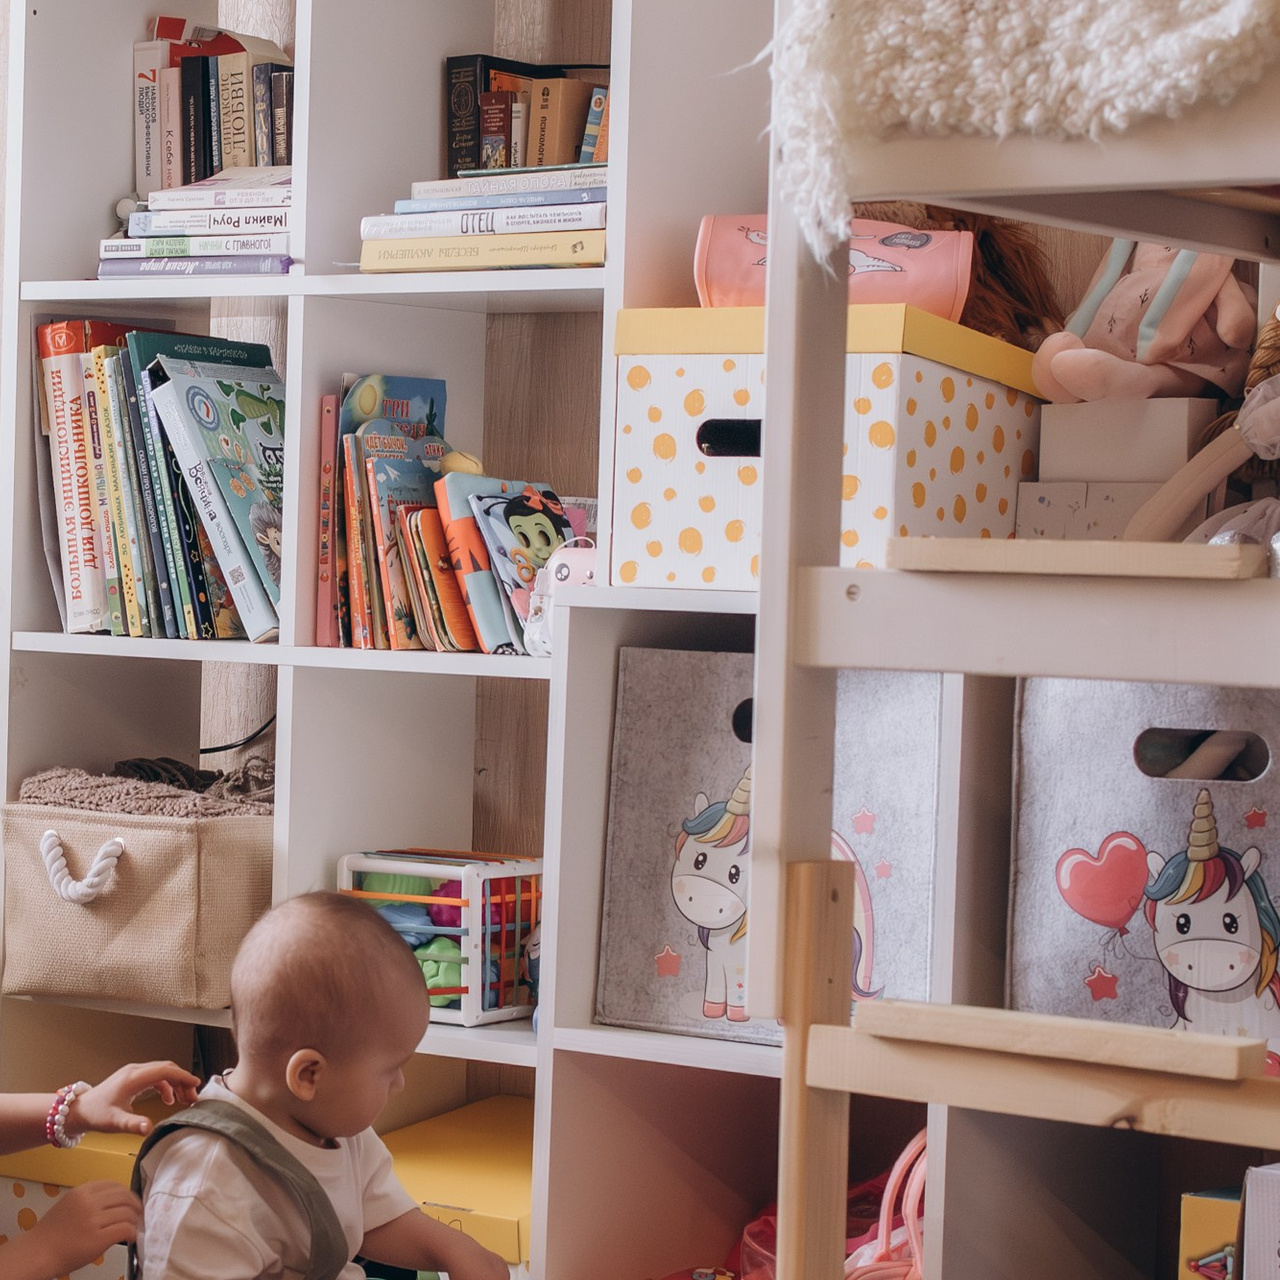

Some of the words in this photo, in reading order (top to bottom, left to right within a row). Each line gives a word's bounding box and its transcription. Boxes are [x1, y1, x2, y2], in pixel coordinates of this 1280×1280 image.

[138, 69, 156, 83] 7
[221, 73, 232, 155] СИНТАКСИС
[231, 72, 246, 153] ЛЮБВИ
[144, 86, 152, 177] ВЫСОКОЭФФЕКТИВНЫХ
[166, 140, 174, 165] себе
[466, 176, 516, 193] ТАЙНАЯ
[517, 174, 567, 190] ОПОРА
[212, 217, 240, 228] Роуч
[245, 214, 283, 228] Майкл
[460, 212, 496, 235] ОТЕЦ
[140, 259, 165, 271] утра
[378, 248, 434, 260] АКУШЕРКИ
[438, 247, 480, 258] БЕСЕДЫ
[166, 261, 199, 274] Магия
[138, 383, 146, 411] ПРУДУ
[383, 399, 410, 418] ТРИ
[103, 407, 112, 439] СКАЗОК
[51, 369, 75, 513] ЭНЦИКЛОПЕДИЯ
[365, 431, 382, 451] ИДЁТ
[69, 395, 96, 532] ДОШКОЛЬНИКА
[107, 442, 119, 492] МАЛЕНЬКИХ
[139, 450, 147, 475] СКАЗКИ
[145, 490, 157, 533] ЕДИНОРОГОВ
[187, 460, 217, 522] Всячина
[103, 509, 111, 533] книга
[115, 496, 126, 539] ЛЮБИМЫХ
[160, 515, 168, 538] ЕНОТ
[65, 516, 83, 601] БОЛЬШАЯ
[82, 536, 99, 570] ДЛЯ
[166, 543, 175, 579] КРОШКА
